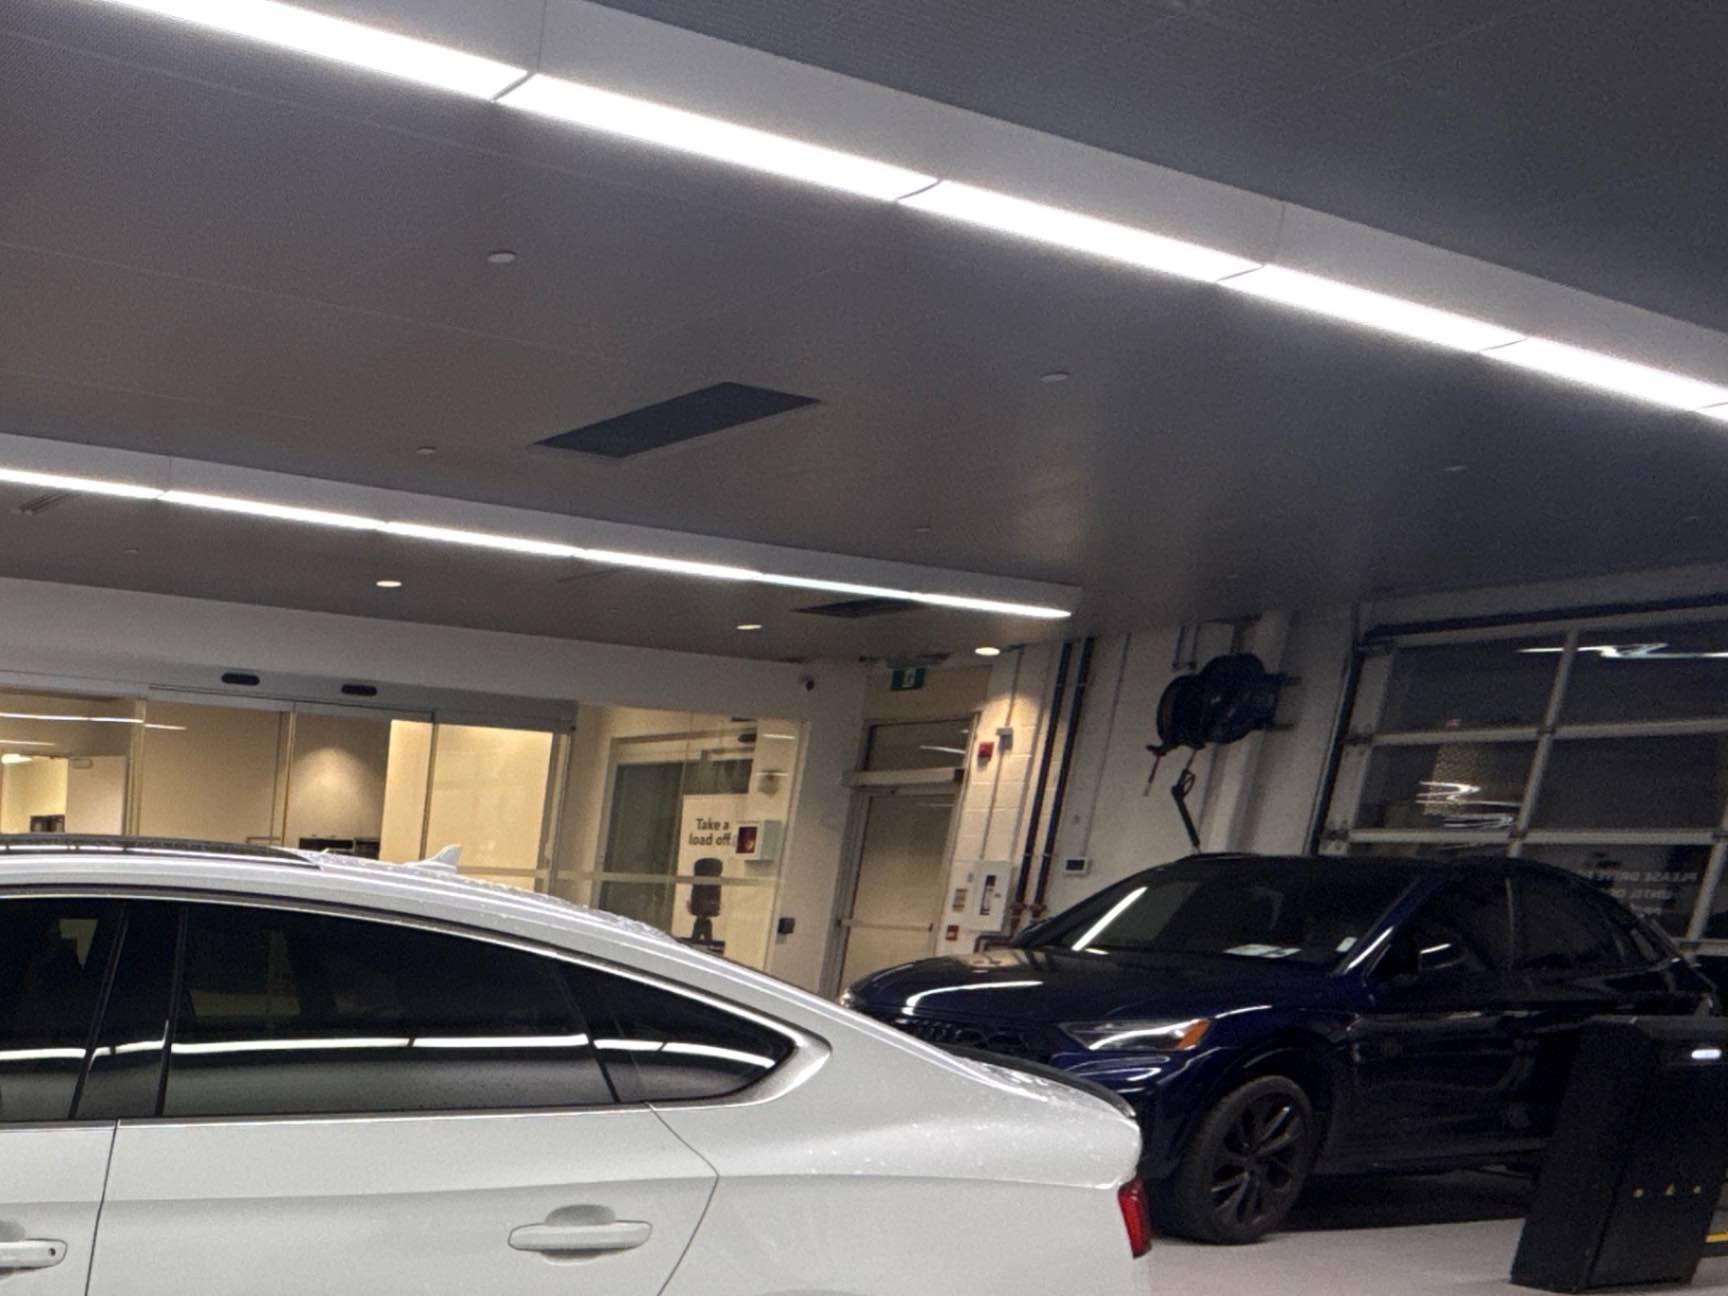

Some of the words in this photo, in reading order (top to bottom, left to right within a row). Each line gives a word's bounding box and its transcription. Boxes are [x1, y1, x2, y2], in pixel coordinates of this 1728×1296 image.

[696, 817, 721, 831] Take
[723, 821, 730, 831] a
[688, 832, 713, 846] load
